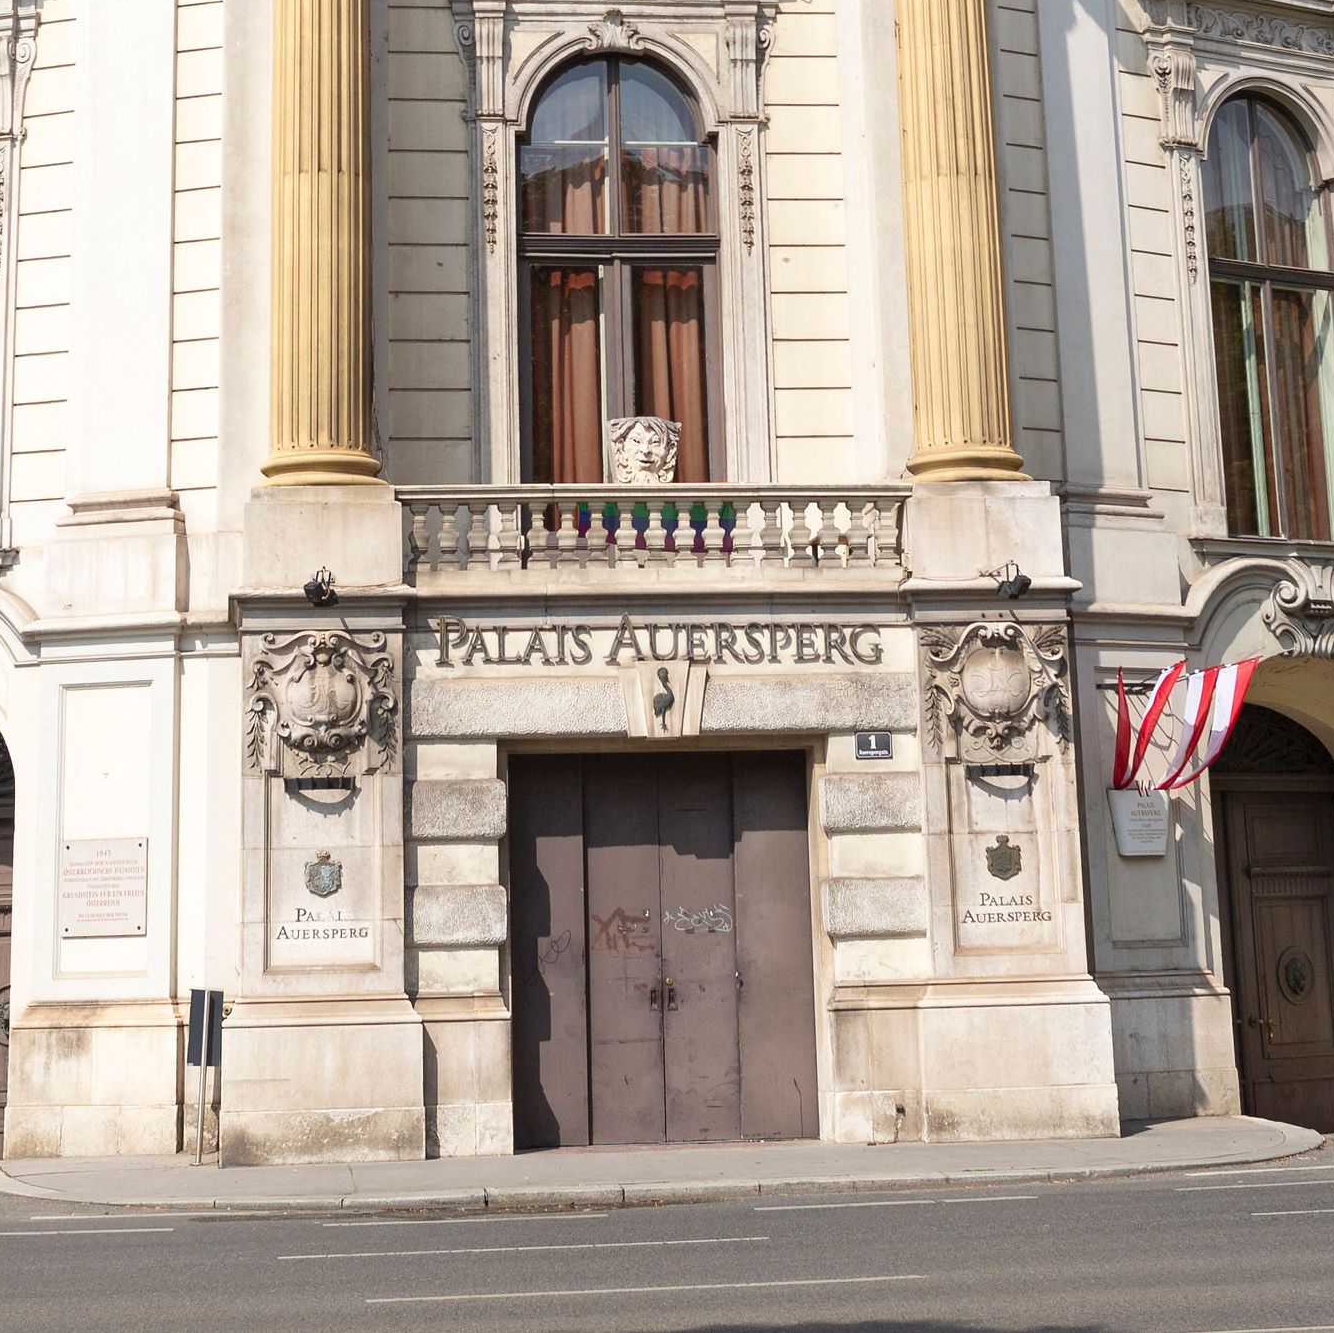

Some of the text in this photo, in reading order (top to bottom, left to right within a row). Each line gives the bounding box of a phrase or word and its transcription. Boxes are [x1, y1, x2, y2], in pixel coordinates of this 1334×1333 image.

[437, 612, 884, 667] PALAIS AUERSPERG
[868, 735, 877, 749] 1
[979, 892, 1033, 906] PALAIS
[962, 909, 1052, 924] AUERSPERG
[276, 925, 370, 940] AUERSPERG
